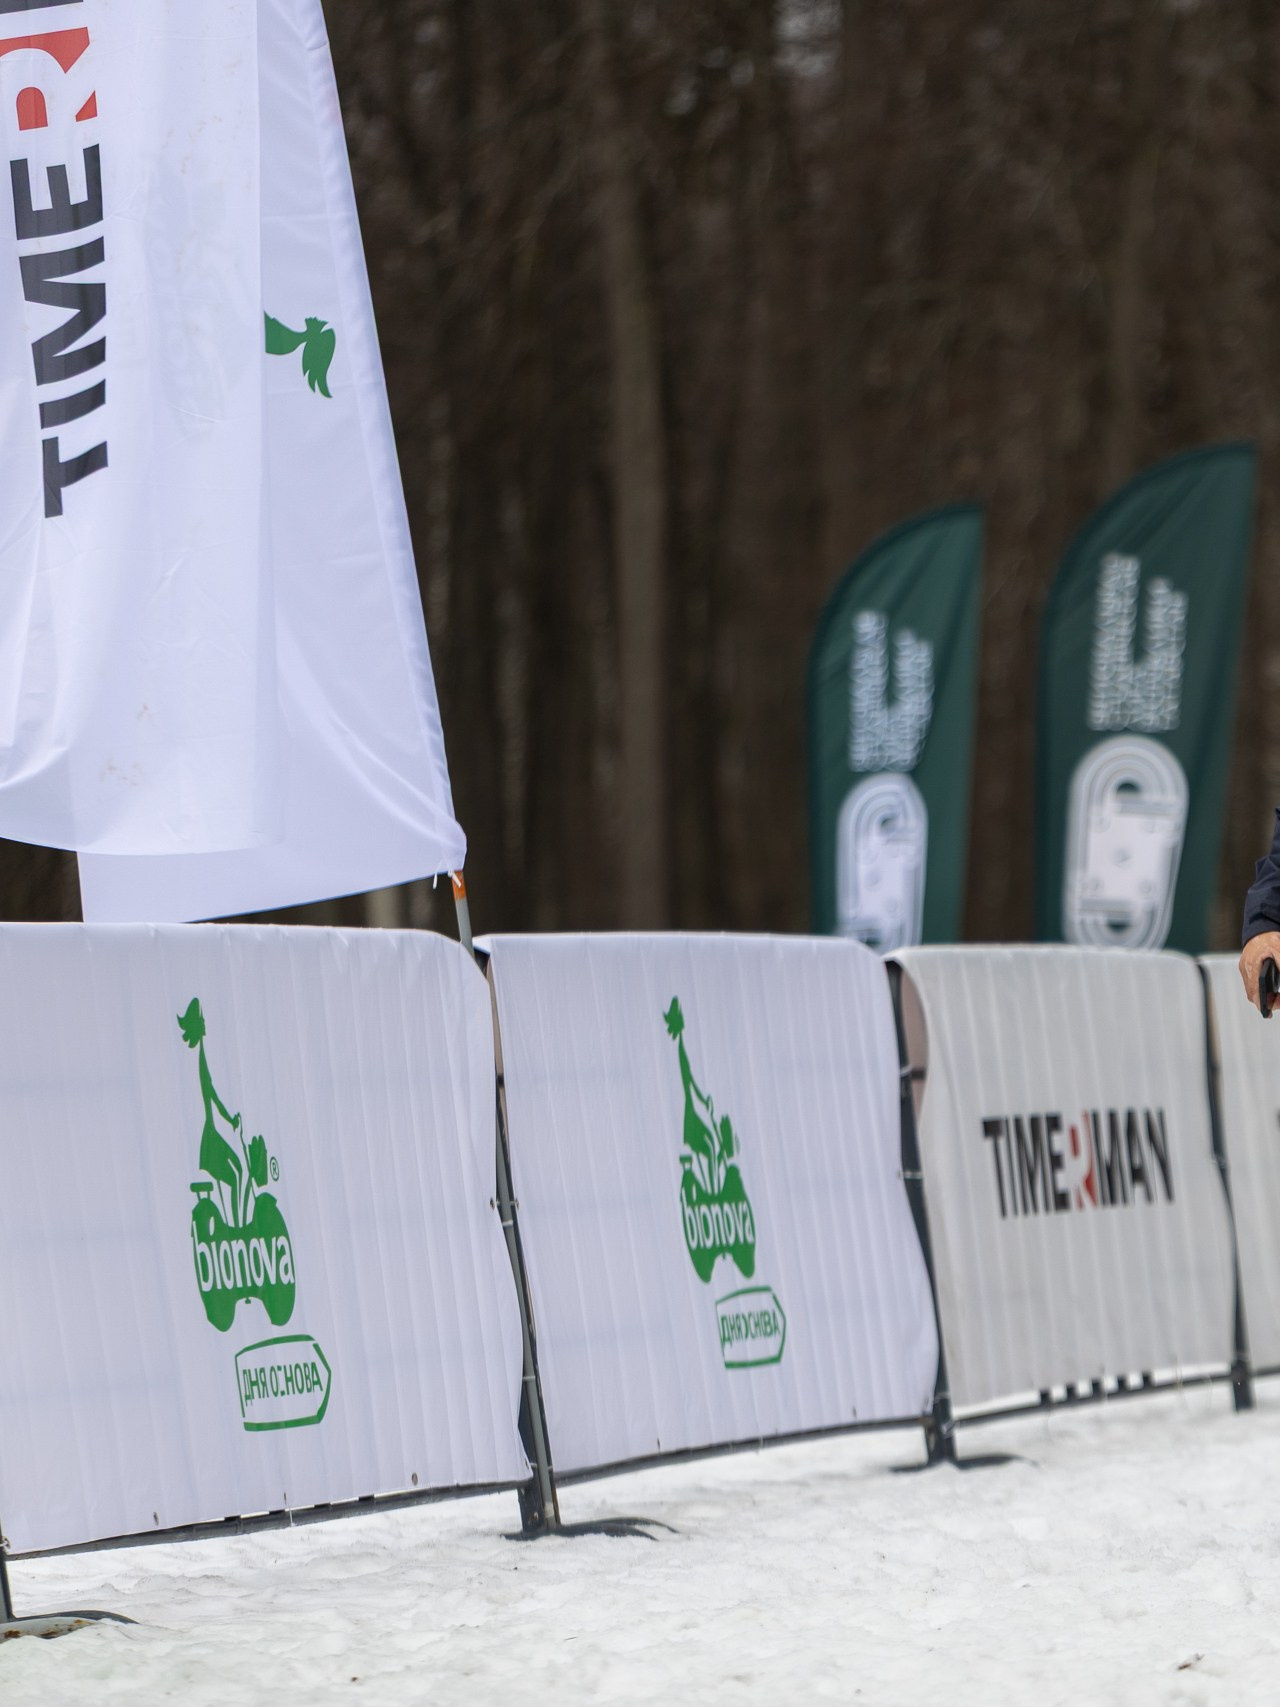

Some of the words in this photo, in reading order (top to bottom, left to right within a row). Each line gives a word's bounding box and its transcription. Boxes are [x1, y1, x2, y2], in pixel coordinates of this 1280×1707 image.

[982, 1107, 1174, 1217] TIMERMAN
[192, 1215, 295, 1292] bionova
[681, 1185, 754, 1251] bionova
[243, 1367, 269, 1406] ДНЯ
